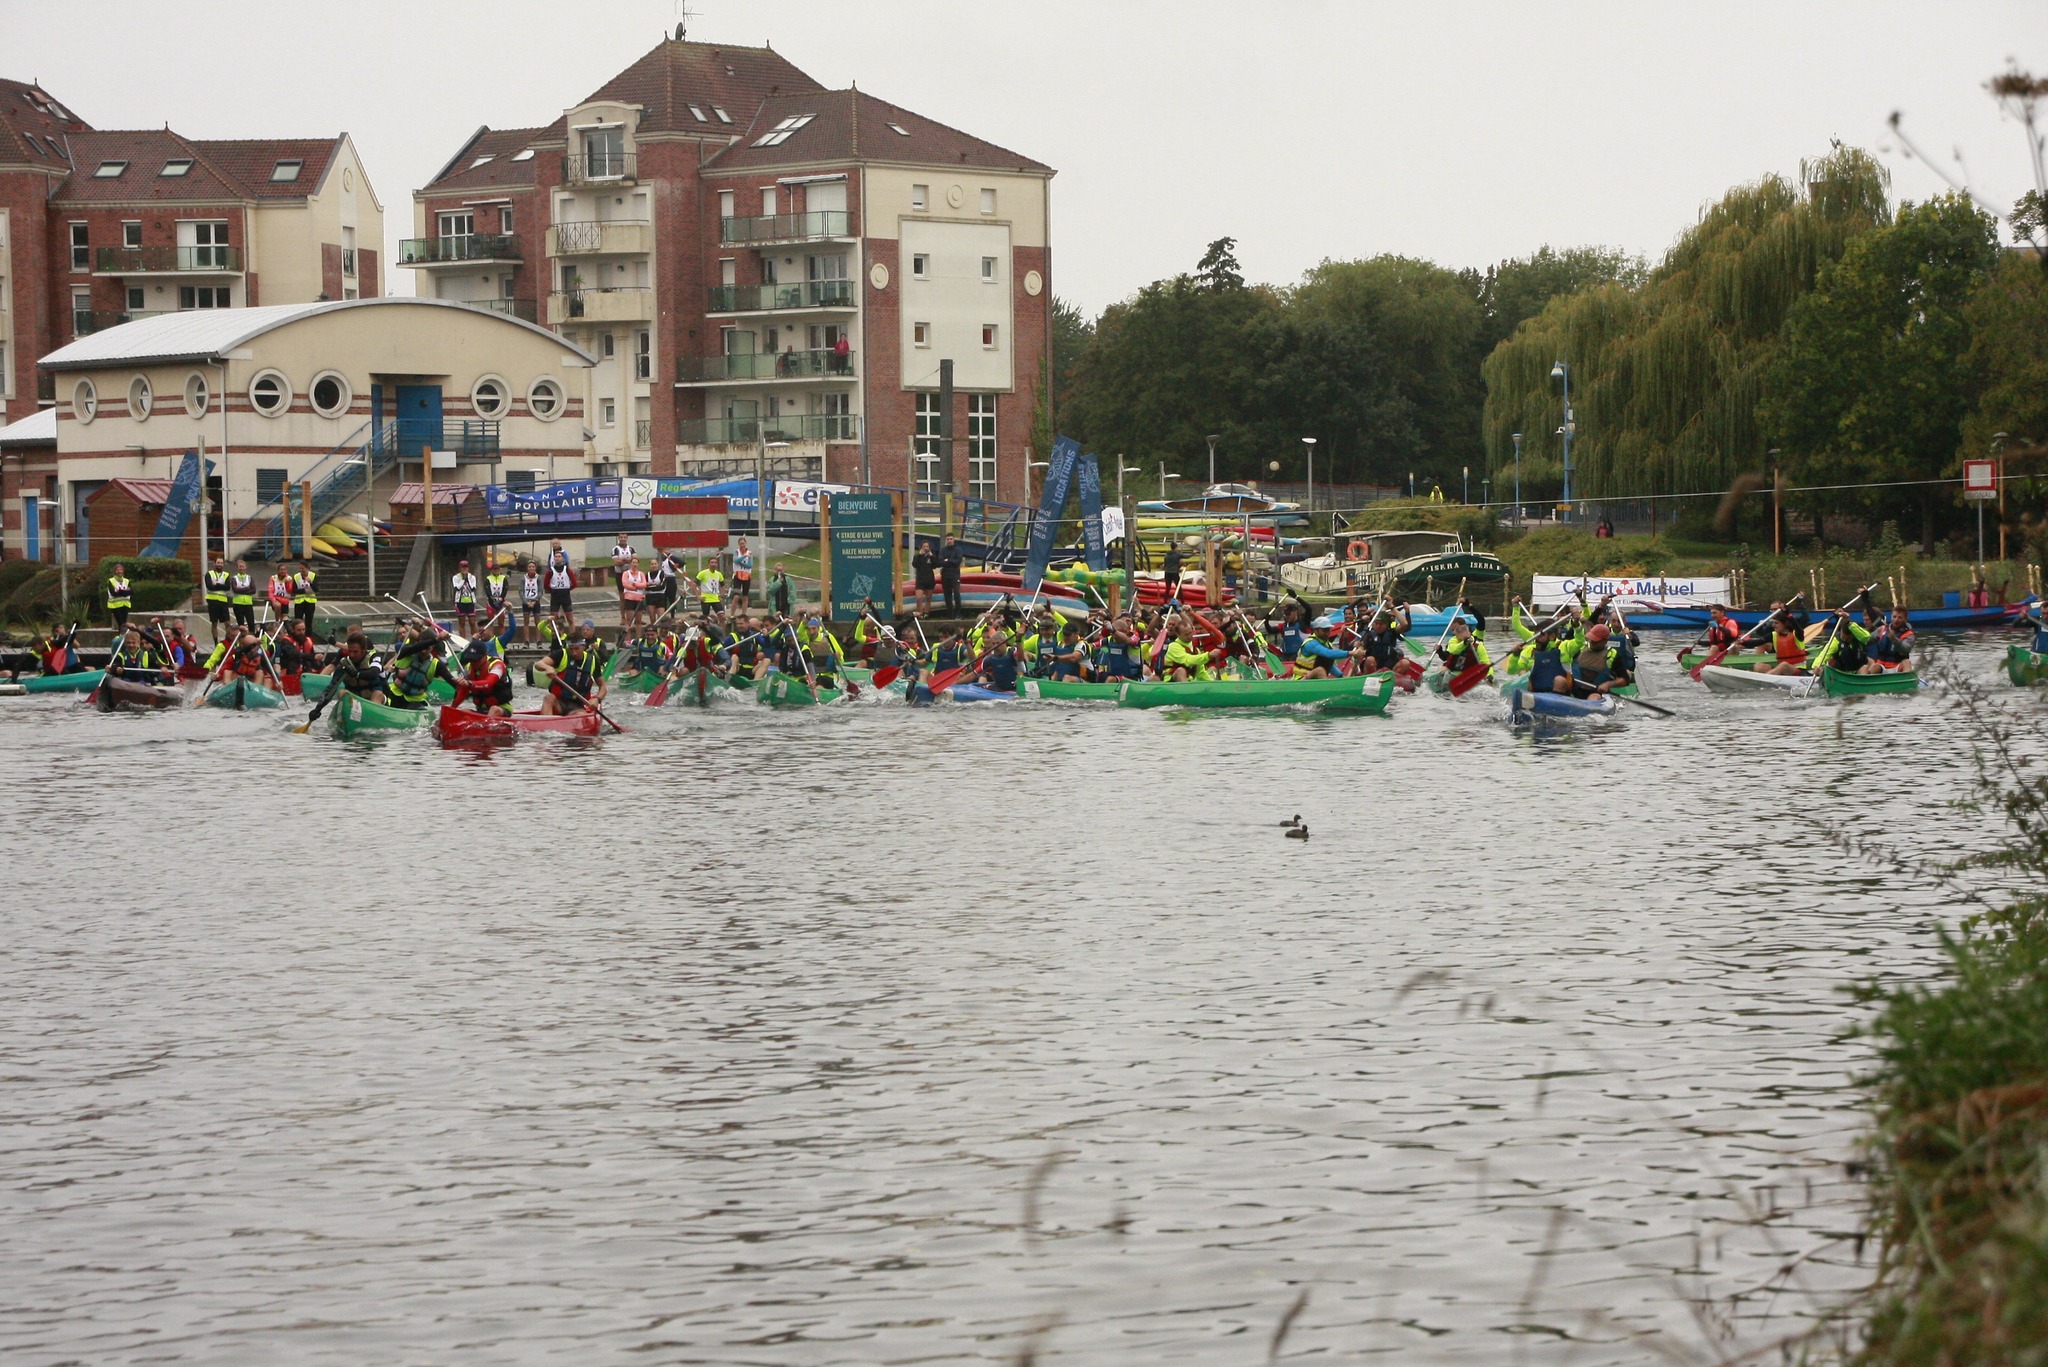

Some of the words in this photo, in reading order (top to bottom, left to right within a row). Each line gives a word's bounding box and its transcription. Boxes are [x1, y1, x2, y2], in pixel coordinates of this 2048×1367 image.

[1053, 450, 1076, 505] LOCATIONS
[515, 496, 594, 510] POPULAIRE
[838, 501, 878, 510] BIENVENUE
[857, 548, 881, 556] NAUTIQUE
[1430, 562, 1460, 572] ISERA
[1470, 561, 1493, 569] ISERA
[1562, 579, 1614, 595] Crédit
[1637, 581, 1694, 596] Mutuel
[526, 588, 537, 598] 75
